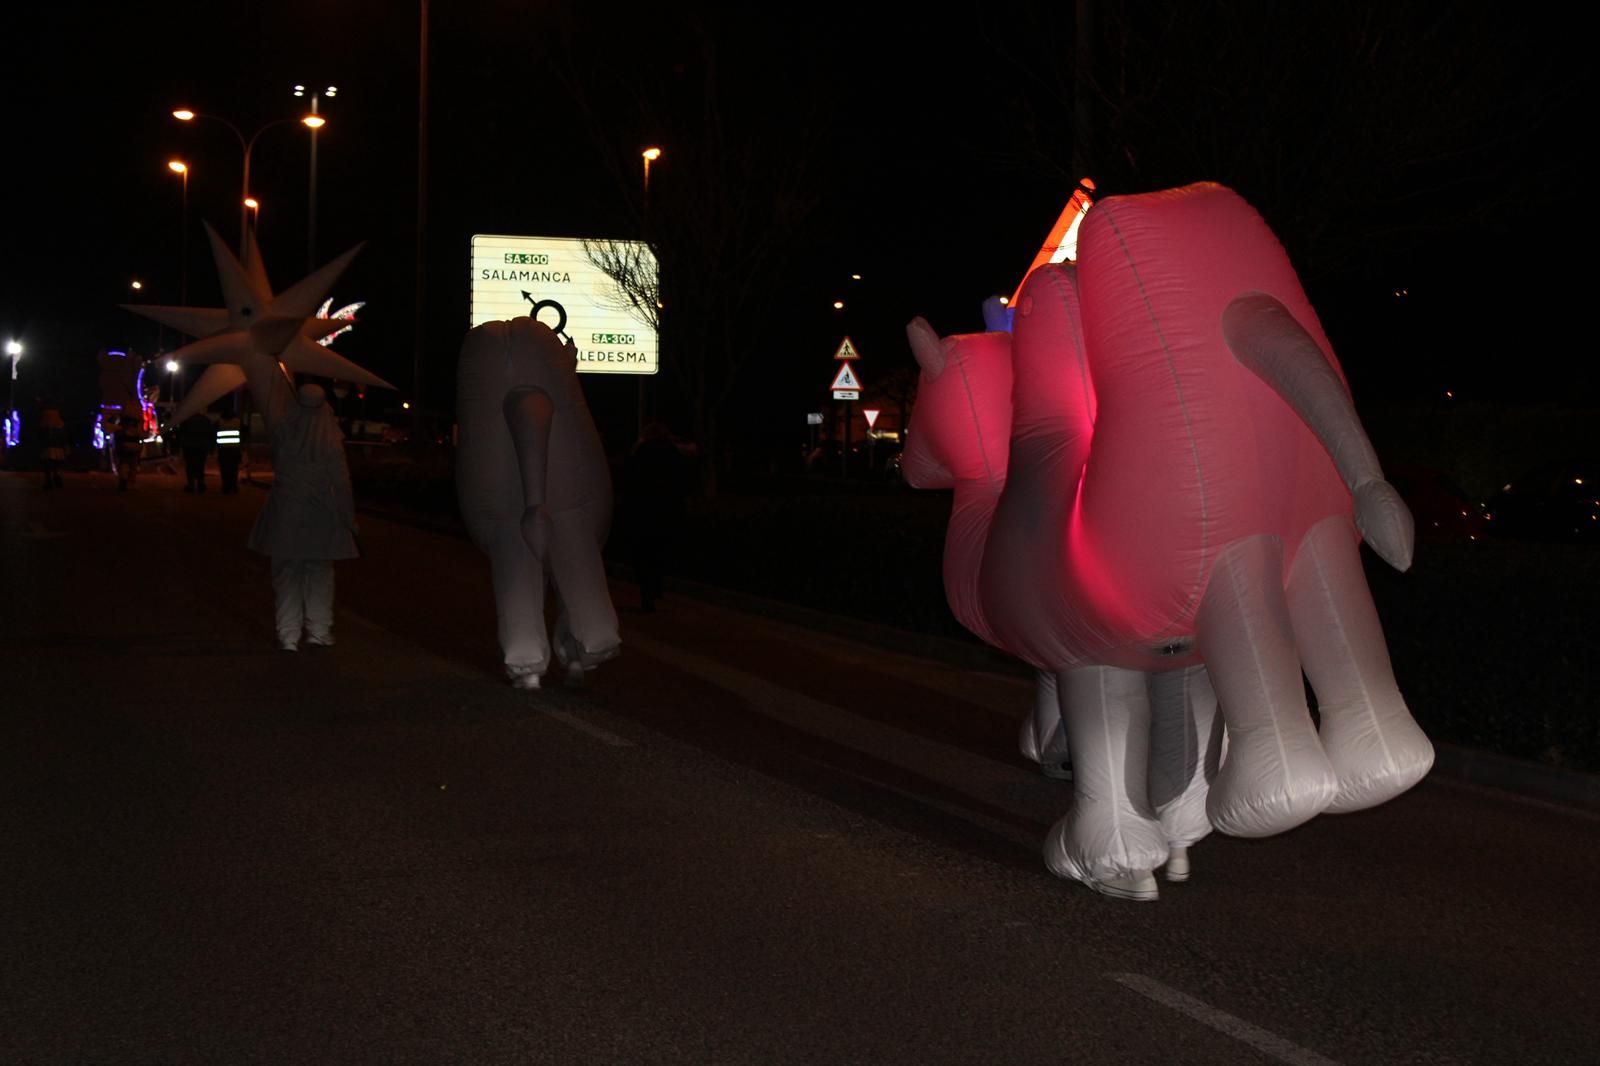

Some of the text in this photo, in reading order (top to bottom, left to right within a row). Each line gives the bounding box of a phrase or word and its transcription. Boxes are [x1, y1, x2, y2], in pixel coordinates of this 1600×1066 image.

[505, 254, 548, 264] SA-300
[482, 269, 571, 283] SALAMANCA
[592, 333, 635, 344] SA-300
[580, 351, 647, 363] LEDESMA
